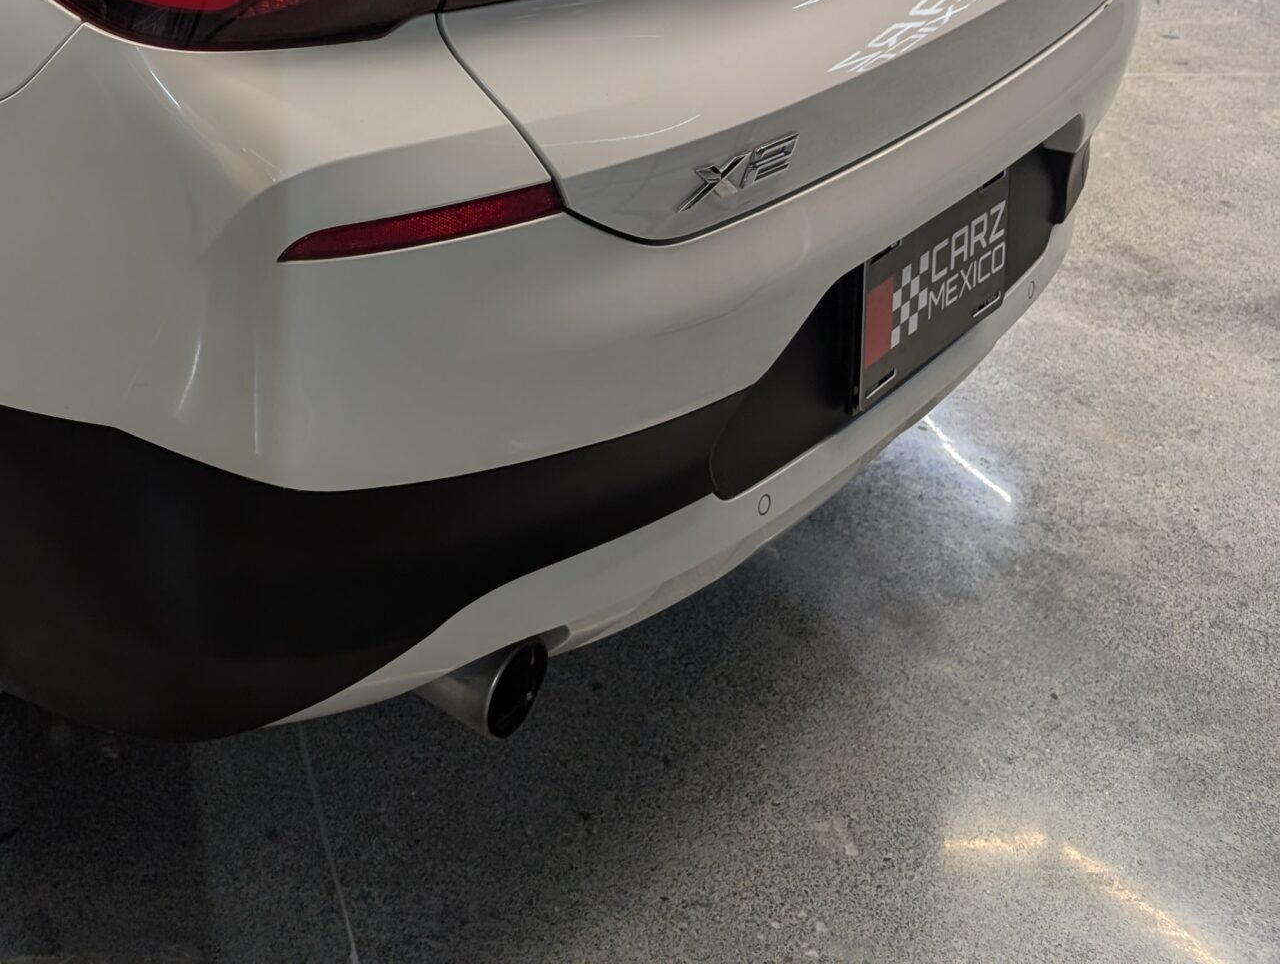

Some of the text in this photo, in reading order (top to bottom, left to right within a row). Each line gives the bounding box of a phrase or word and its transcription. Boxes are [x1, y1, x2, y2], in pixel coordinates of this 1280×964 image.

[675, 132, 800, 213] X2
[927, 241, 1006, 320] MEXICO
[931, 199, 1007, 283] CARZ
